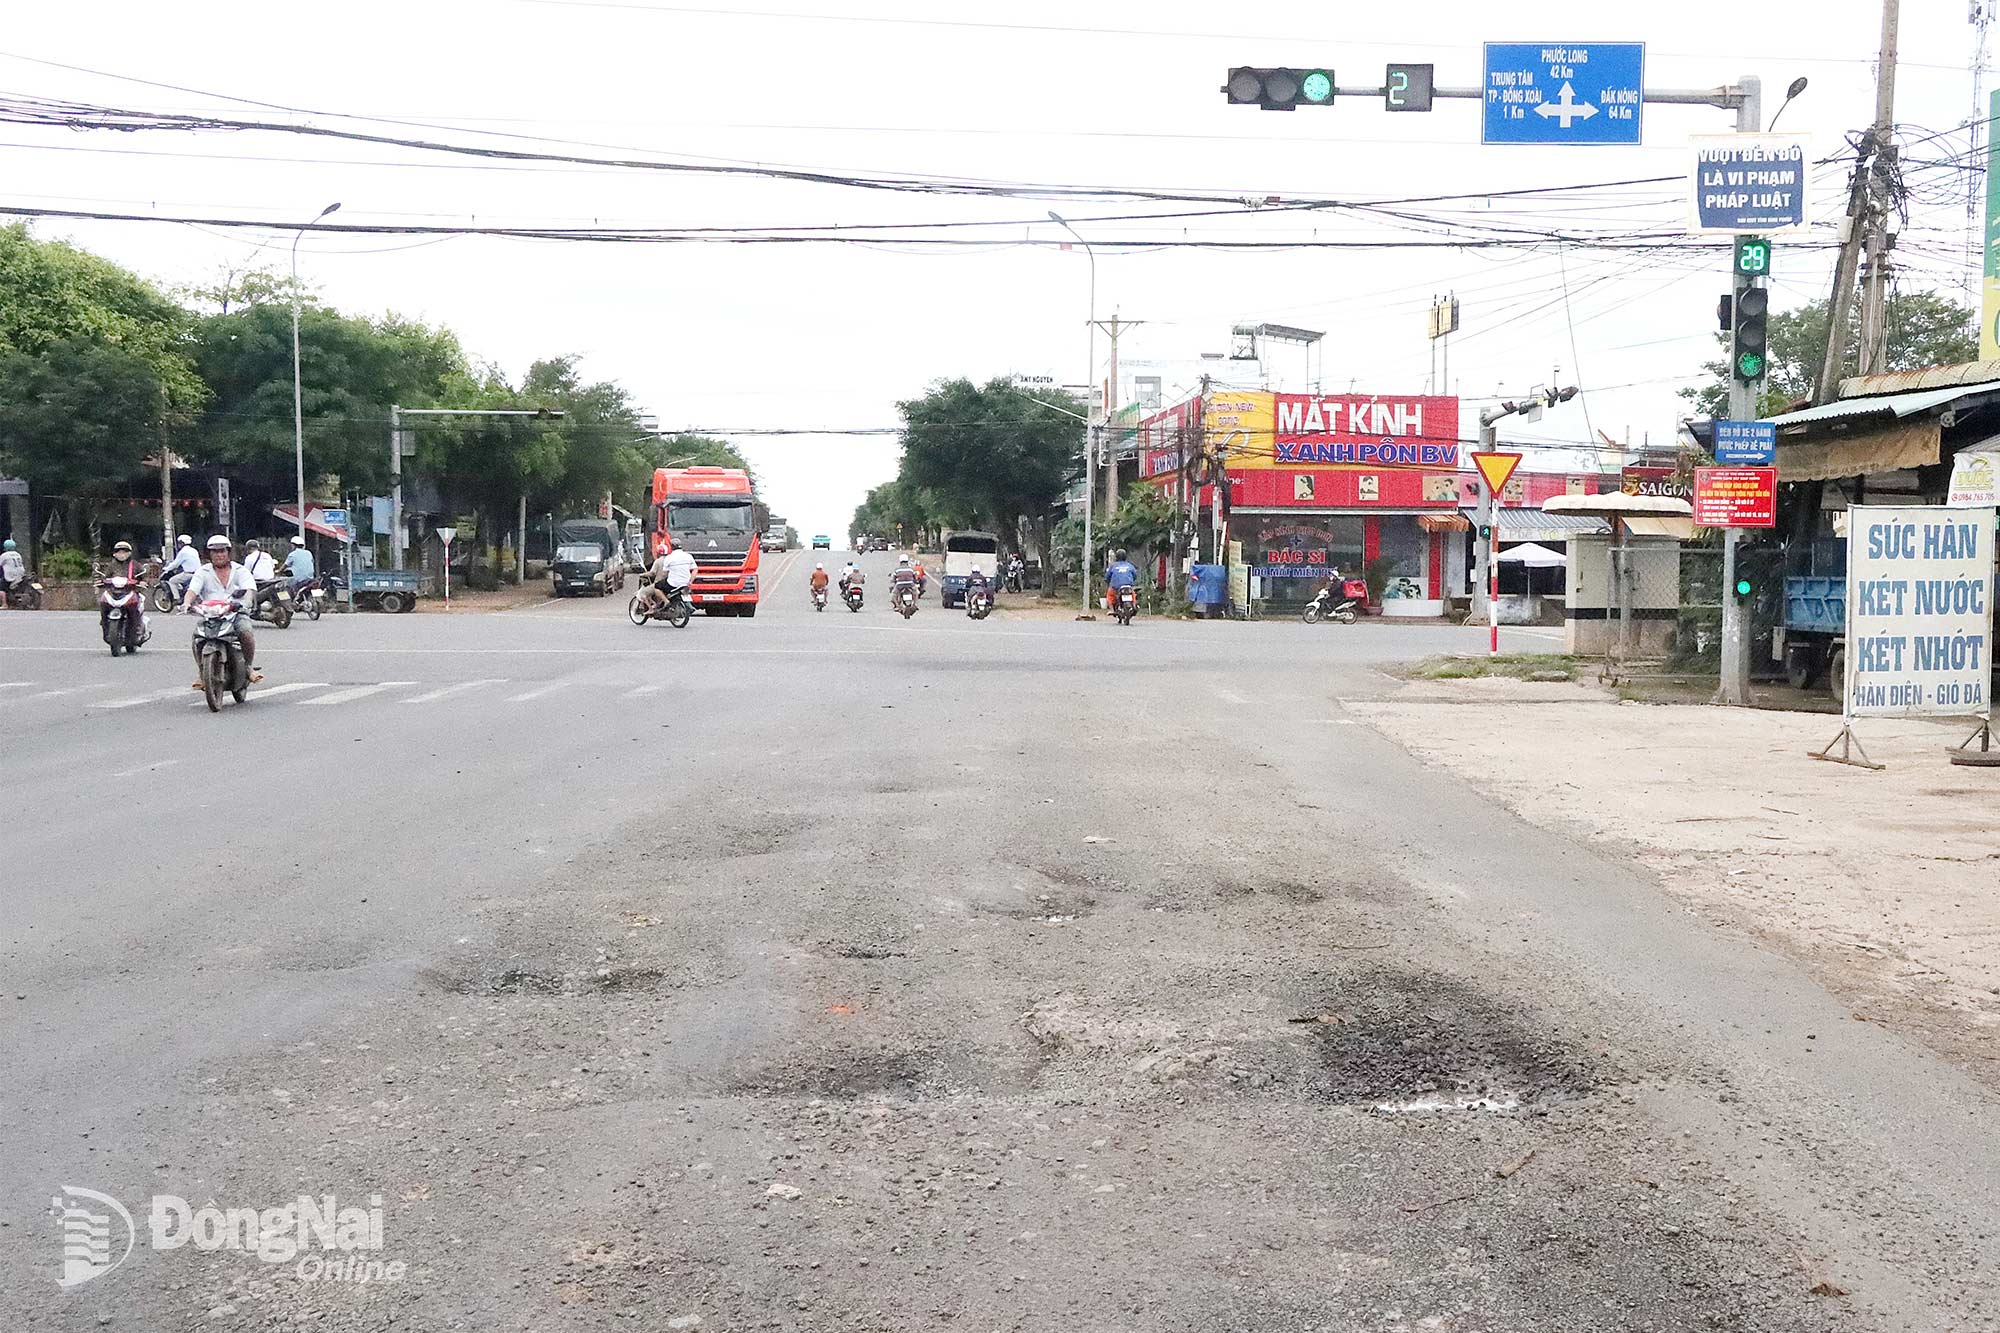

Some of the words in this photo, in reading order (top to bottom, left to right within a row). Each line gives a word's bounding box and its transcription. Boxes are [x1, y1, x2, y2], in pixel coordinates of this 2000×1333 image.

[1568, 49, 1588, 63] LONG
[1491, 72, 1516, 86] TRUNG
[1517, 69, 1533, 86] TÂM
[1550, 66, 1560, 78] 42
[1561, 66, 1573, 78] Km
[1389, 71, 1408, 104] 2
[1524, 87, 1542, 103] XOÀI
[1511, 105, 1524, 119] Km
[1608, 106, 1618, 119] 64
[1619, 106, 1632, 119] Km
[1704, 169, 1724, 186] LÀ
[1727, 172, 1744, 186] VI
[1747, 171, 1795, 187] PHẠM
[1705, 191, 1749, 208] PHÁP
[1752, 191, 1791, 210] LUẬT
[1740, 245, 1765, 271] 29
[1278, 394, 1343, 435] MẮT
[1349, 395, 1423, 436] KÍNH
[1276, 442, 1355, 463] XANH
[1358, 436, 1417, 464] PÔN
[1421, 443, 1458, 464] BV
[1638, 481, 1693, 497] SAIGON
[1868, 517, 1916, 560] SÚC
[1923, 518, 1978, 560] HÀN
[1267, 547, 1303, 564] BÁC
[1858, 573, 1908, 616] KÉT
[1914, 572, 1984, 616] NƯỚC
[1858, 629, 1907, 672] KÉT
[1913, 628, 1984, 672] NHỚT
[1856, 681, 1885, 707] HÀN
[1936, 679, 1959, 705] GIÓ
[1963, 678, 1983, 705] ĐÁ
